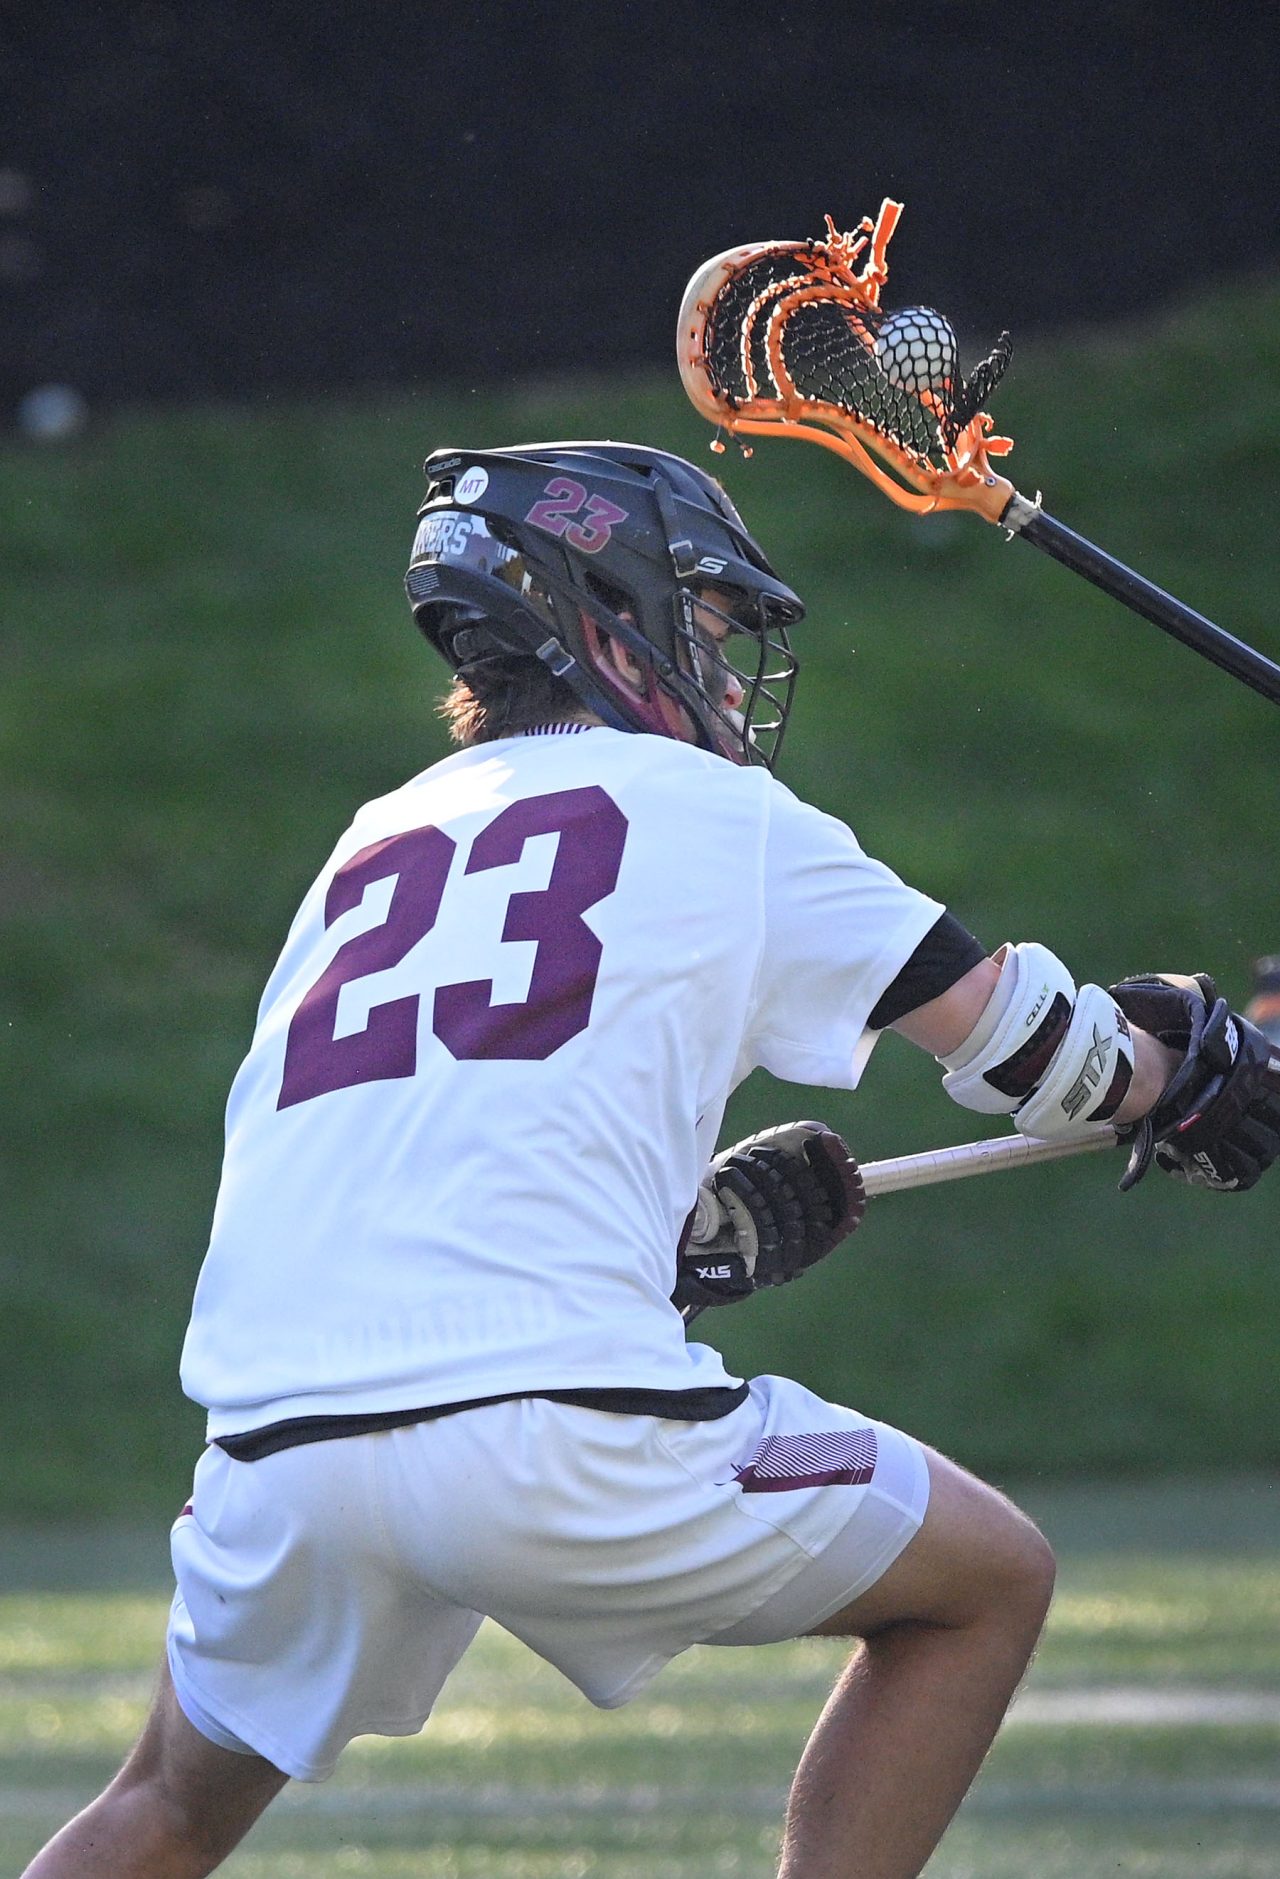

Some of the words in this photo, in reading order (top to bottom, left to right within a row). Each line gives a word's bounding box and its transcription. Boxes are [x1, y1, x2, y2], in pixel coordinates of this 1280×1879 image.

[460, 479, 484, 494] MT
[524, 477, 629, 554] 23
[276, 785, 629, 1113] 23
[1060, 1021, 1113, 1122] STX
[1193, 1151, 1223, 1183] STX
[695, 1264, 732, 1280] STX
